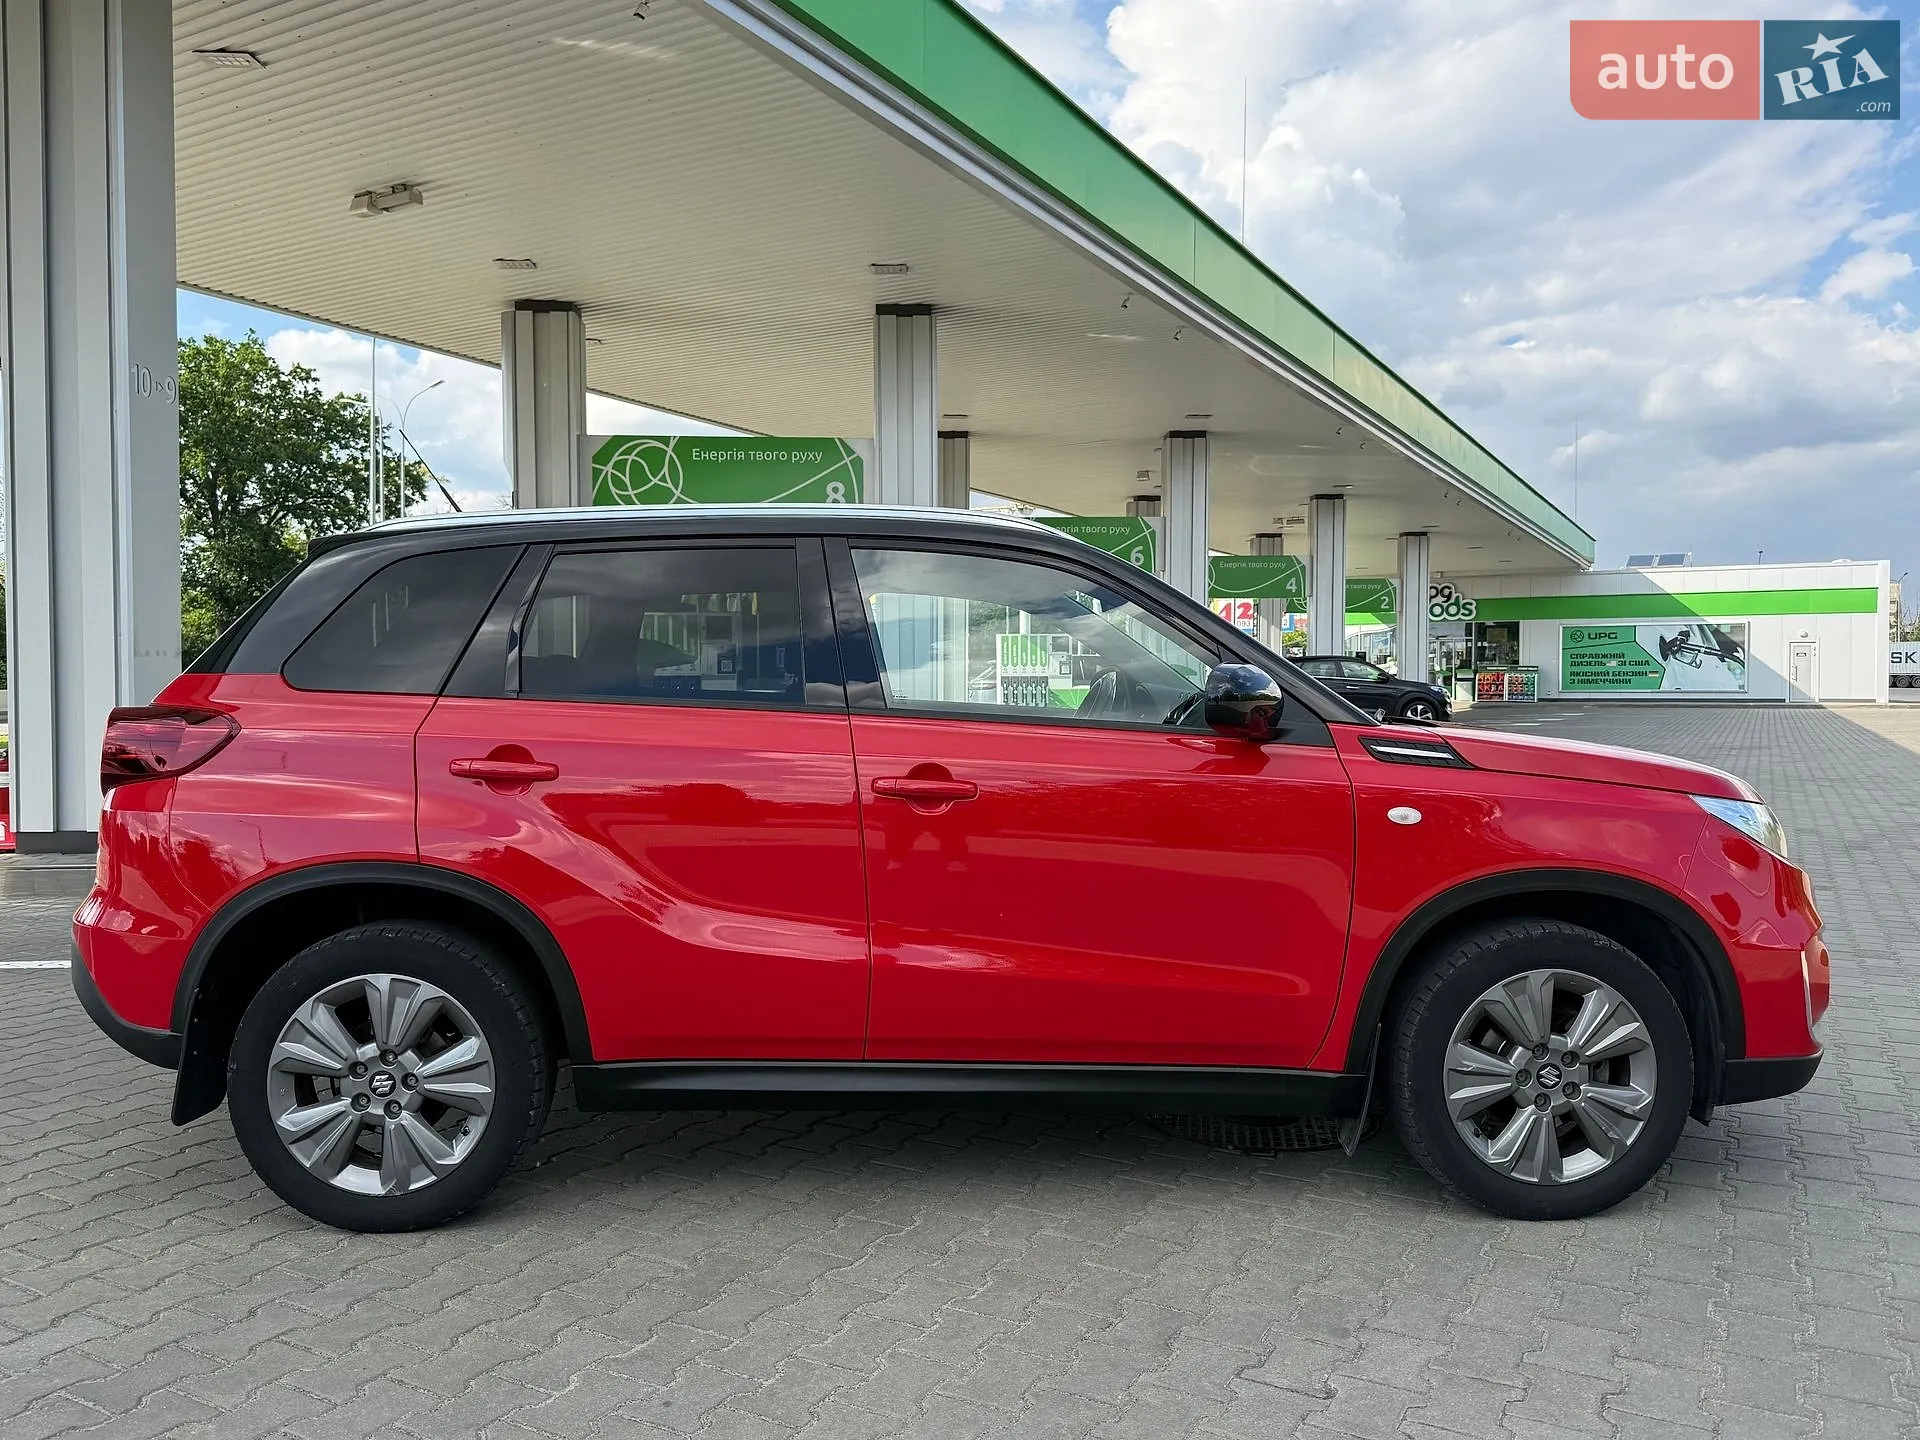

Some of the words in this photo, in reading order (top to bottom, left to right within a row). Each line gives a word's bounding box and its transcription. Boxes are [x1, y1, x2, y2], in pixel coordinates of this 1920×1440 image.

[692, 448, 745, 462] Енергія
[748, 450, 787, 461] твого
[791, 450, 823, 463] руху
[825, 481, 846, 503] 8
[1109, 526, 1131, 535] руху
[1130, 546, 1145, 566] 6
[1286, 577, 1298, 593] 4
[1380, 596, 1390, 609] 2
[1587, 632, 1618, 640] UPG
[1569, 652, 1625, 660] СПРАВЖНІЙ
[1890, 651, 1917, 664] SK
[1628, 659, 1650, 667] США
[1569, 670, 1610, 678] ЯКІСНИЙ
[1611, 670, 1648, 678] БЕНЗИН
